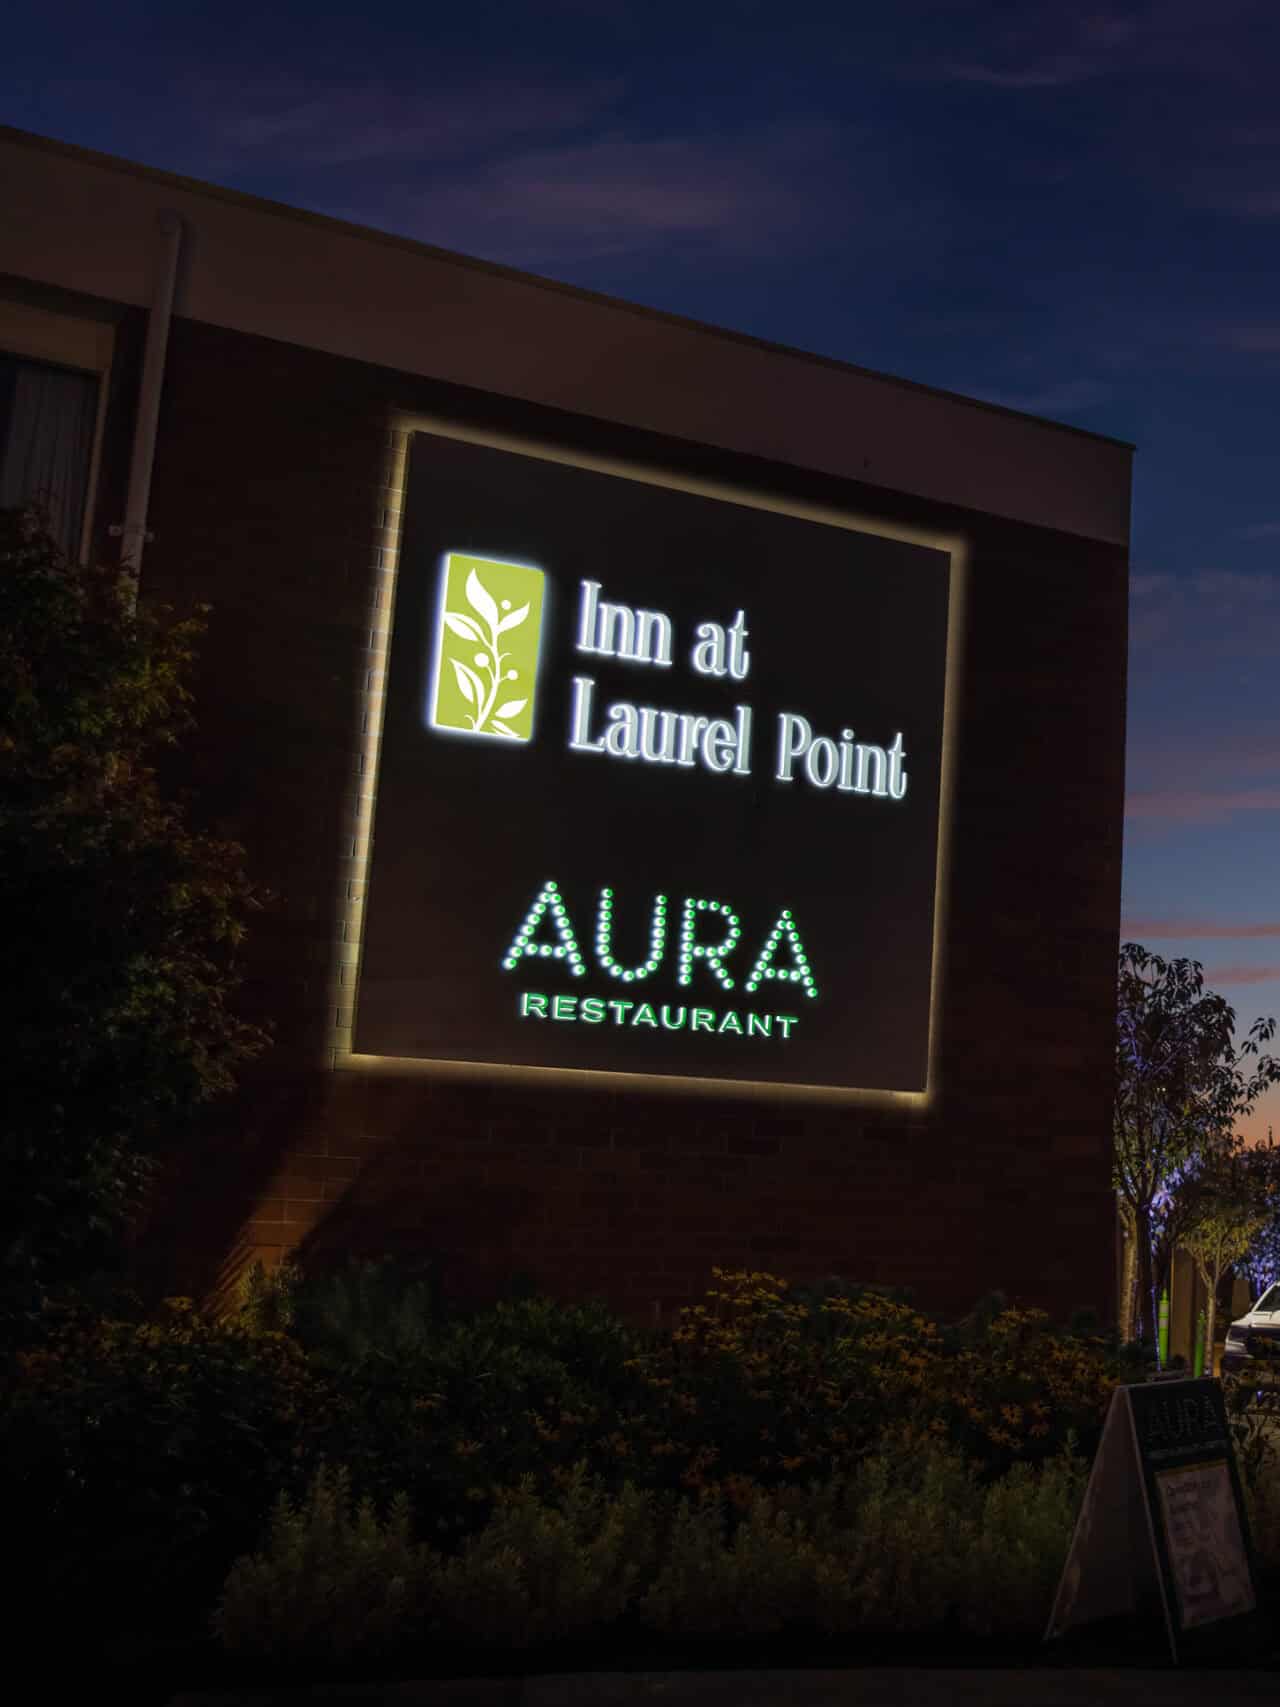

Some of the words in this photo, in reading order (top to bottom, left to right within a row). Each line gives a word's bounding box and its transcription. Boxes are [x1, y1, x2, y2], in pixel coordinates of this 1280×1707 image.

[577, 579, 673, 665] Inn
[692, 609, 751, 680] at
[569, 676, 752, 775] Laurel
[776, 711, 908, 799] Point
[501, 880, 819, 999] AURA
[519, 992, 799, 1039] RESTAURANT
